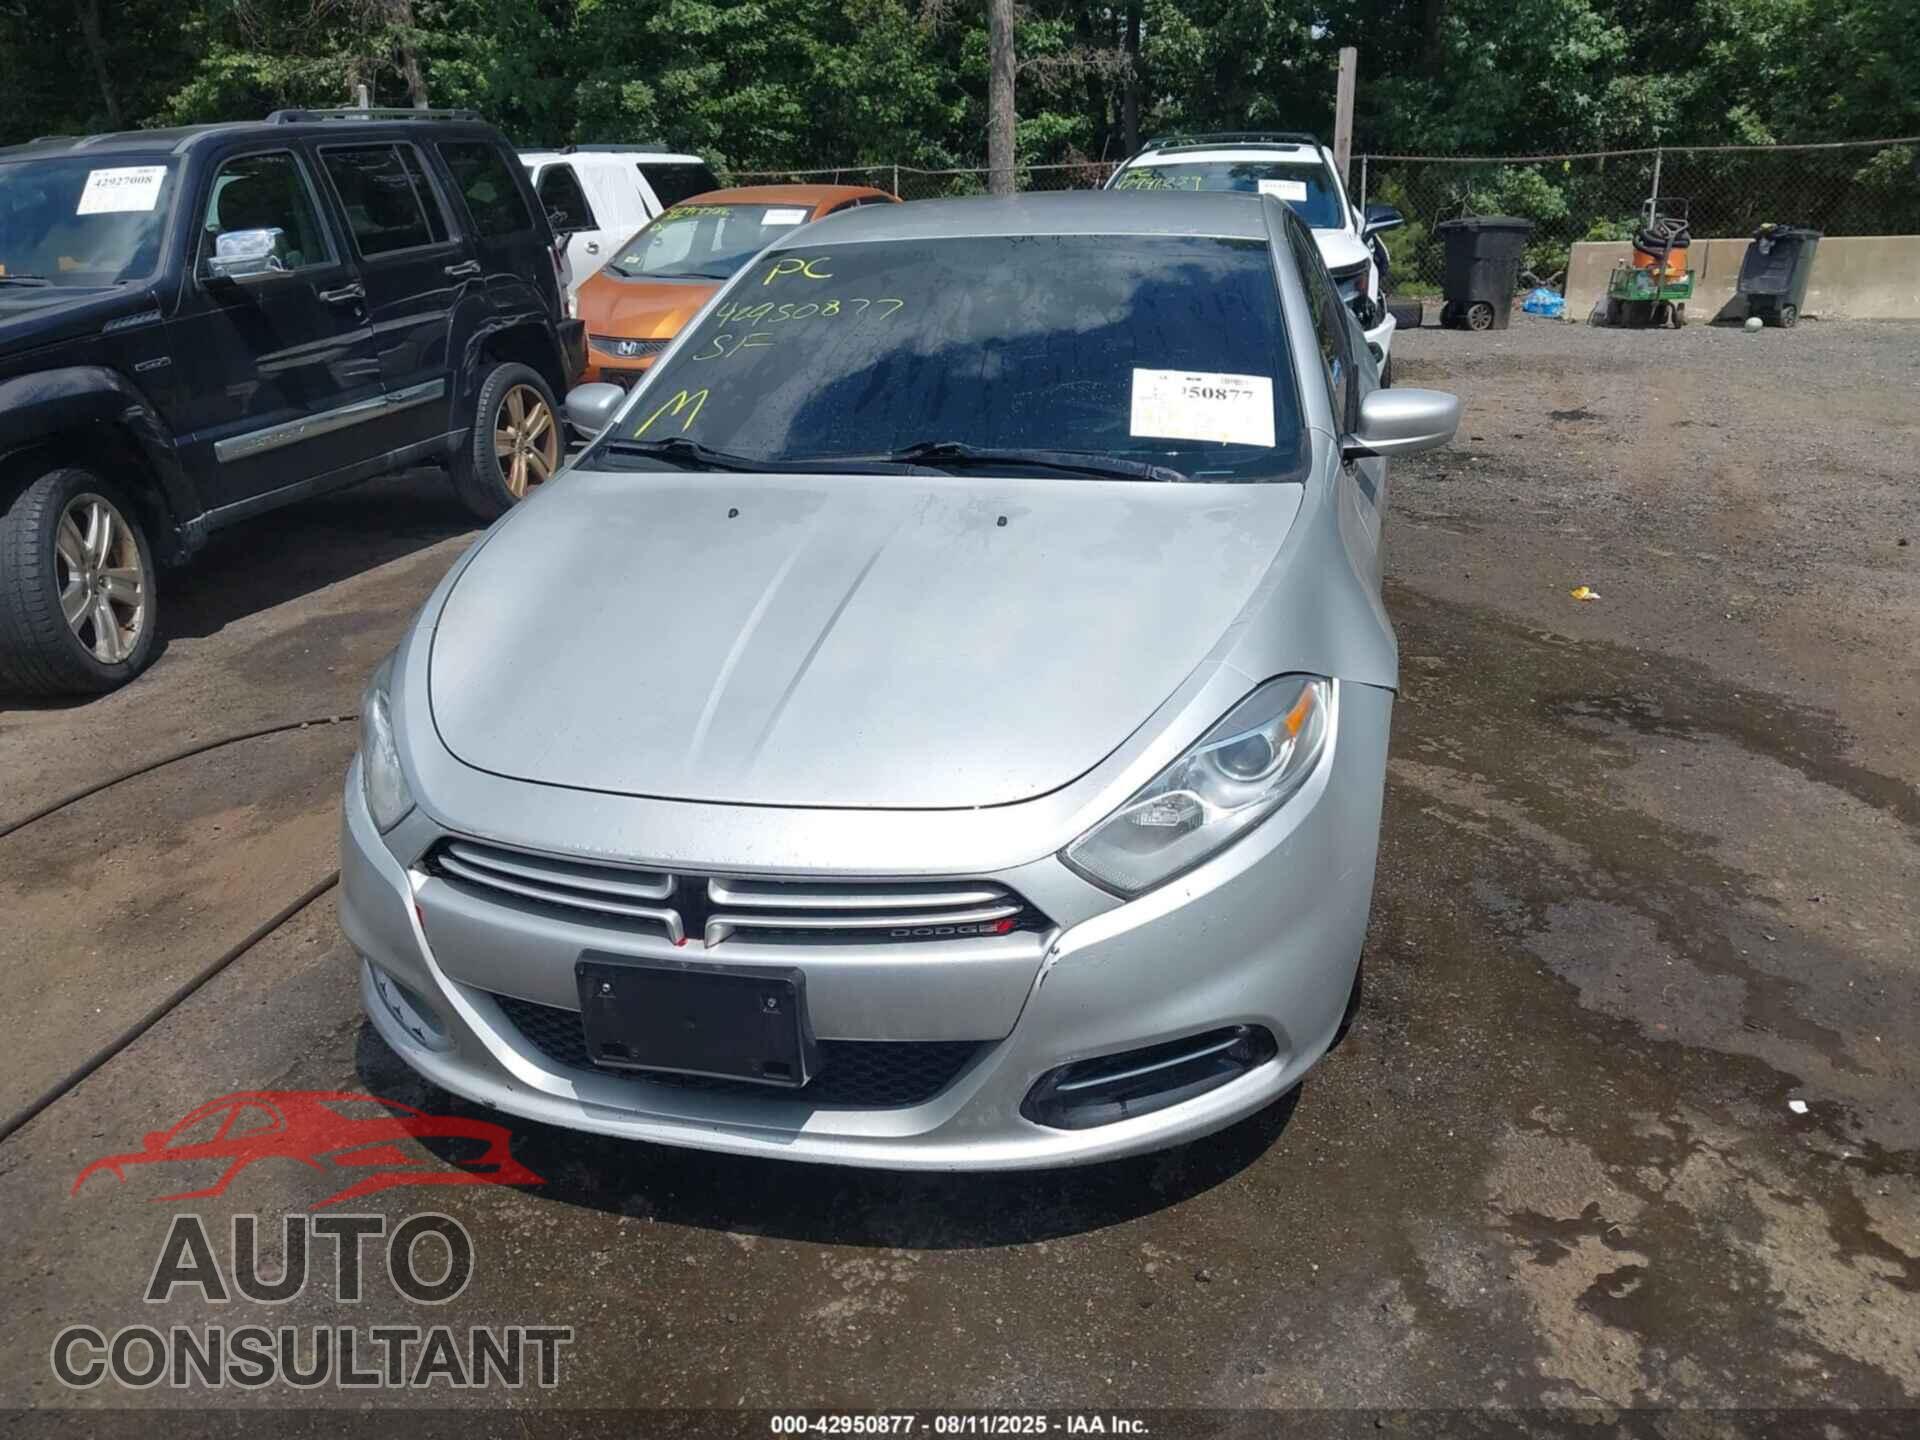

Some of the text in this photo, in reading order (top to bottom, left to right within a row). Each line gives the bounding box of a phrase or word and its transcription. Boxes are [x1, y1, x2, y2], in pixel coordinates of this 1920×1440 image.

[763, 257, 833, 286] PC
[633, 389, 709, 439] M
[890, 924, 998, 937] DODGE
